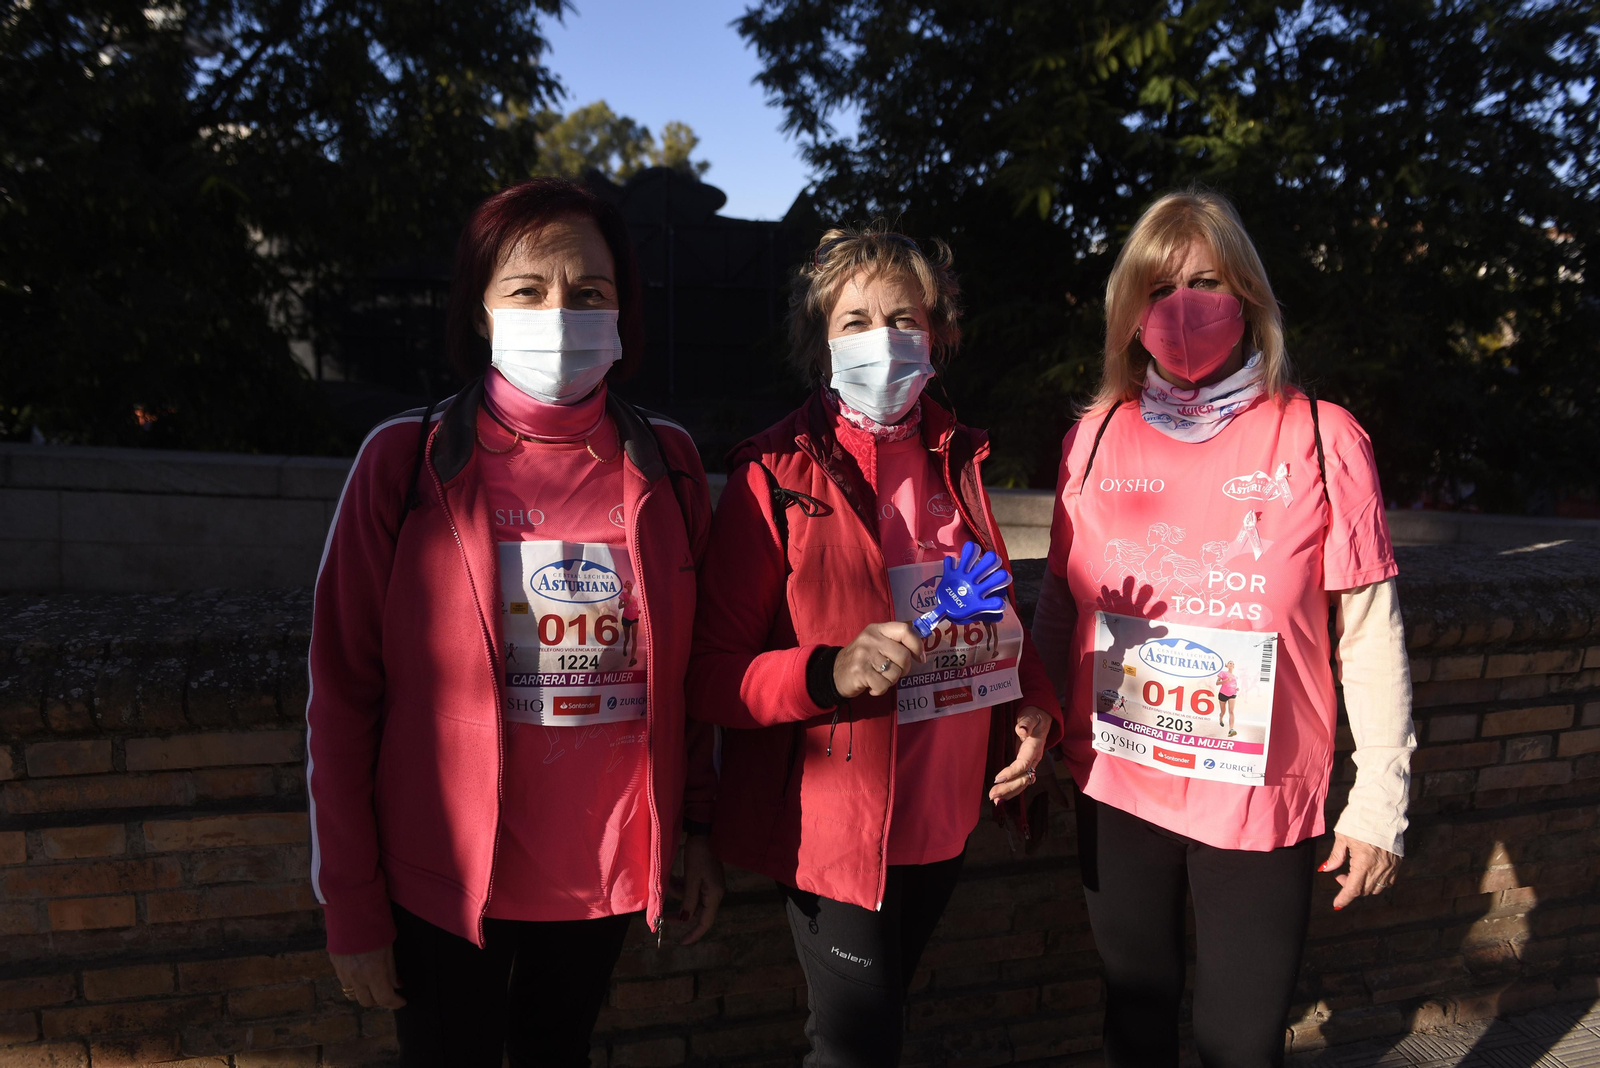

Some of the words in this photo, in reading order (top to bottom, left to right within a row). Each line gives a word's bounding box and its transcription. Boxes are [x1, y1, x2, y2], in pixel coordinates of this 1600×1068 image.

[1100, 478, 1165, 493] OYSHO
[495, 509, 545, 526] SHO
[538, 573, 617, 593] ASTURIANA
[1208, 570, 1266, 594] POR
[945, 587, 965, 608] ZURICH
[1171, 596, 1263, 621] TODAS
[538, 613, 620, 646] 016
[558, 655, 599, 670] 1224
[933, 654, 967, 668] 1223
[1144, 647, 1217, 671] ASTURIANA
[512, 674, 566, 685] CARRERA
[569, 674, 586, 685] DE
[587, 673, 601, 684] LA
[603, 672, 634, 683] MUJER
[900, 673, 942, 687] CARRERA
[944, 670, 956, 680] DE
[957, 669, 968, 678] LA
[970, 662, 996, 675] MUJER
[989, 680, 1012, 692] ZURICH
[620, 697, 648, 706] ZURICH
[898, 697, 928, 712] SHO
[945, 692, 968, 700] Santander
[1142, 680, 1215, 716] 016
[507, 698, 544, 713] SHO
[568, 702, 596, 710] Santander
[1156, 715, 1193, 733] 2203
[1100, 730, 1147, 755] OYSHO
[1123, 720, 1164, 740] CARRERA
[1165, 732, 1180, 743] DE
[1182, 735, 1195, 746] LA
[1197, 738, 1235, 750] MUJER
[1163, 754, 1190, 764] Santander
[1219, 762, 1253, 773] ZURICH
[831, 946, 872, 967] Kalenji
